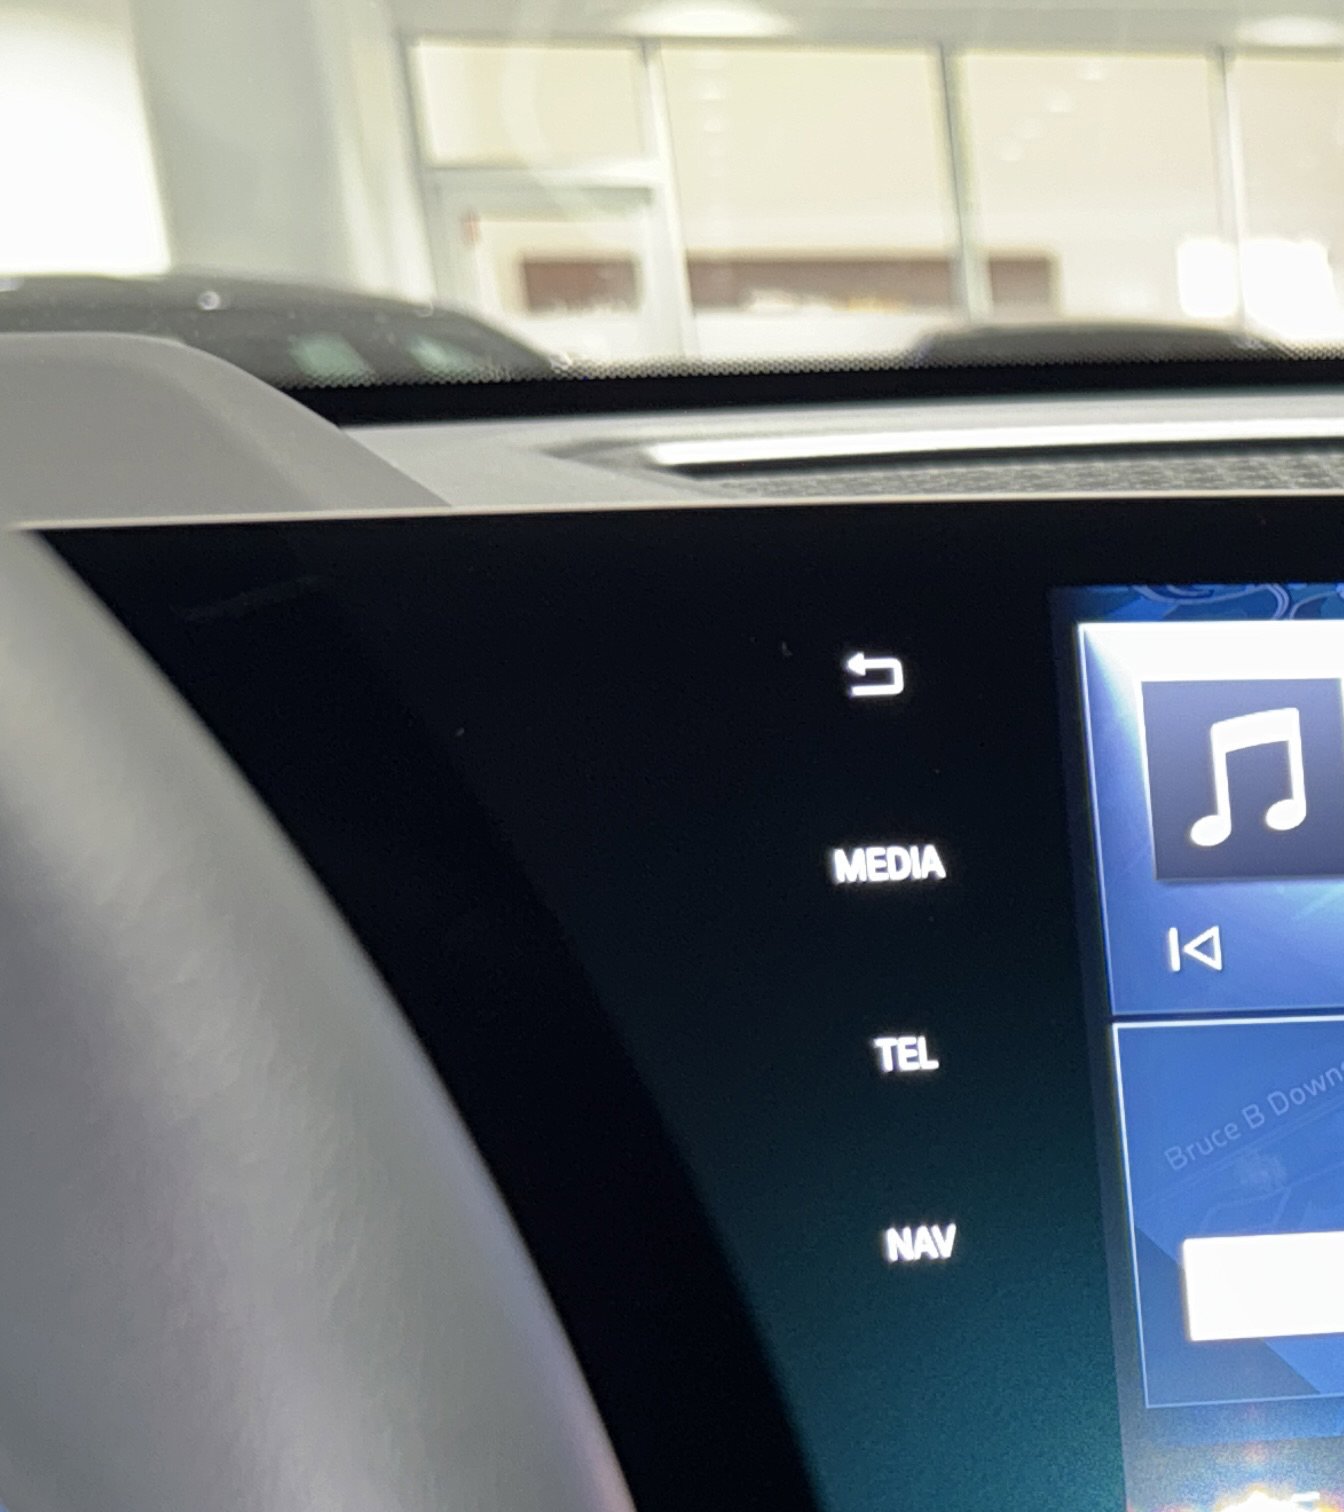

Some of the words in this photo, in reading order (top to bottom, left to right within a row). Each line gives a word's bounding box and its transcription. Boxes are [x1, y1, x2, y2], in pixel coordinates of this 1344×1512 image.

[833, 843, 946, 883] MEDIA
[874, 1035, 939, 1072] TEL
[1164, 1121, 1242, 1172] Bruce
[1242, 1103, 1266, 1130] B
[885, 1222, 957, 1261] NAV
